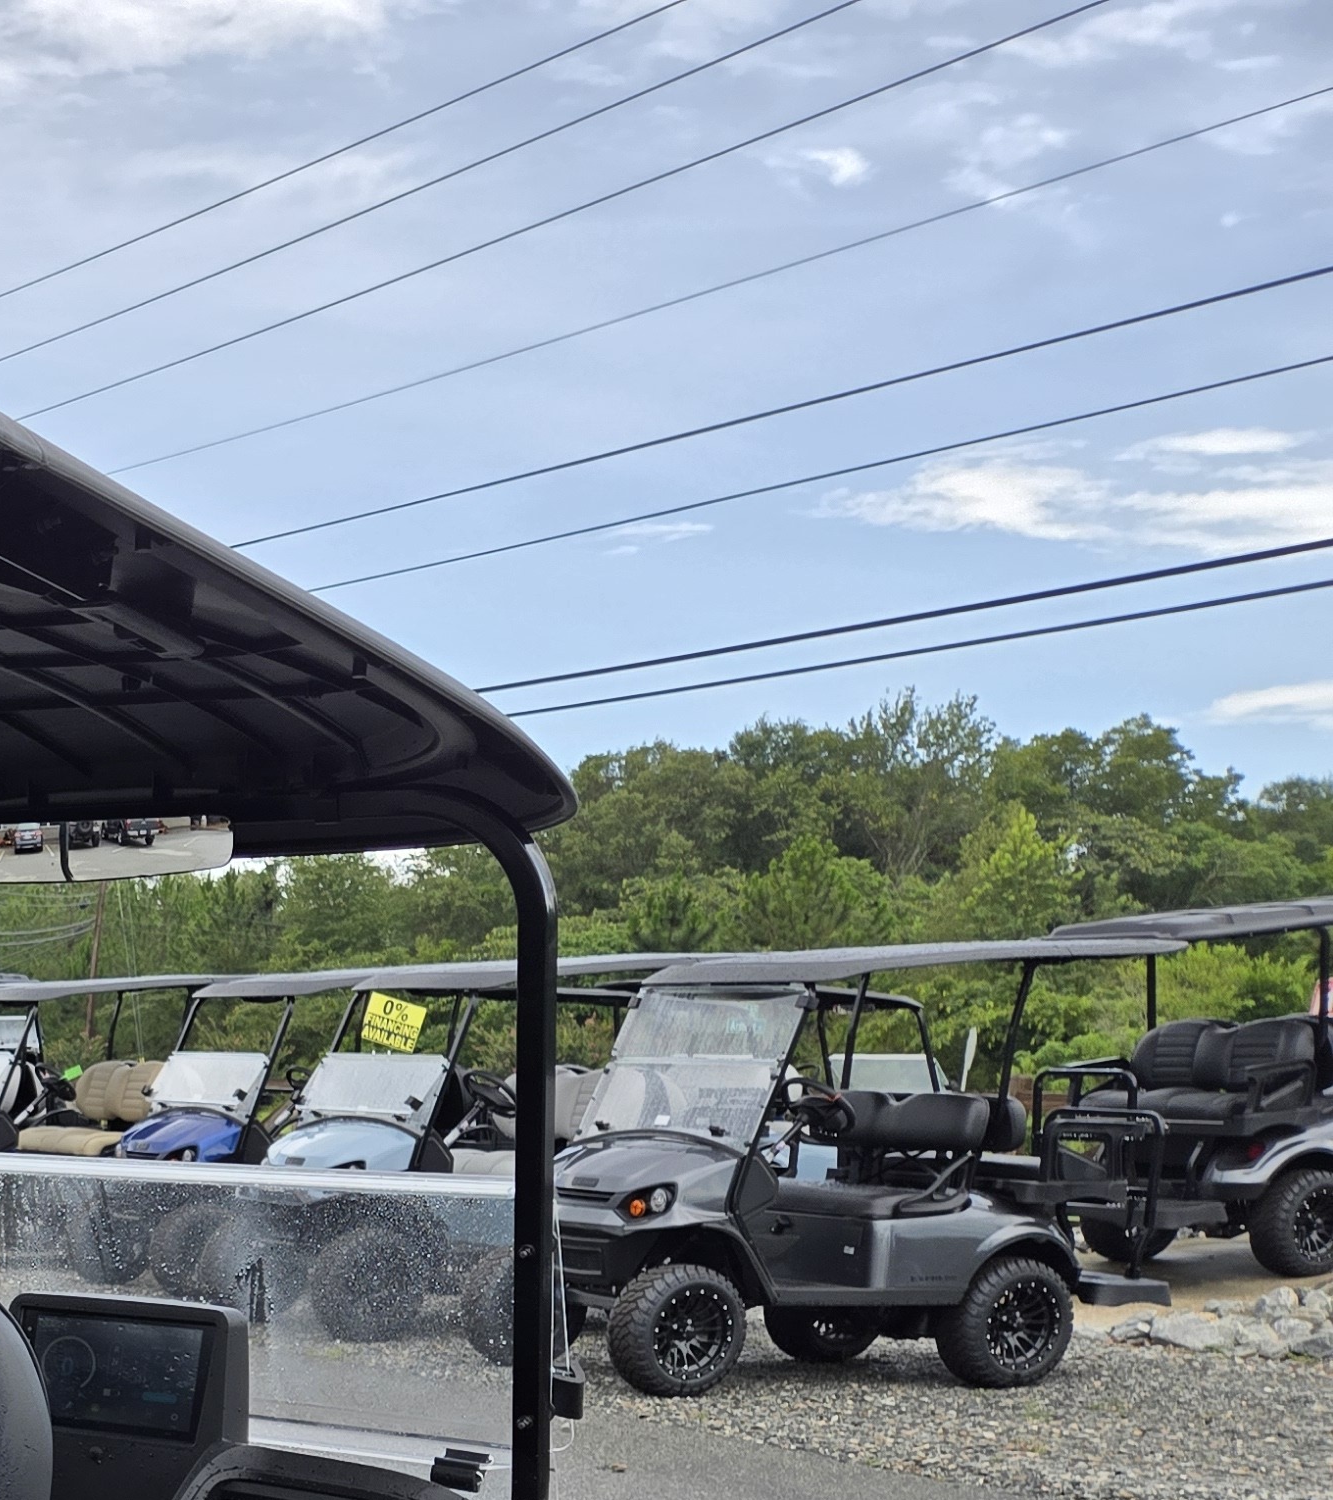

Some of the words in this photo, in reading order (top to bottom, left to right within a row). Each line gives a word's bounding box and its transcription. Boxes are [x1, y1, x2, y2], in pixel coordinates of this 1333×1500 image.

[383, 999, 409, 1022] 0%
[362, 1025, 415, 1052] AVAILABLE
[366, 1013, 418, 1040] FINANCING
